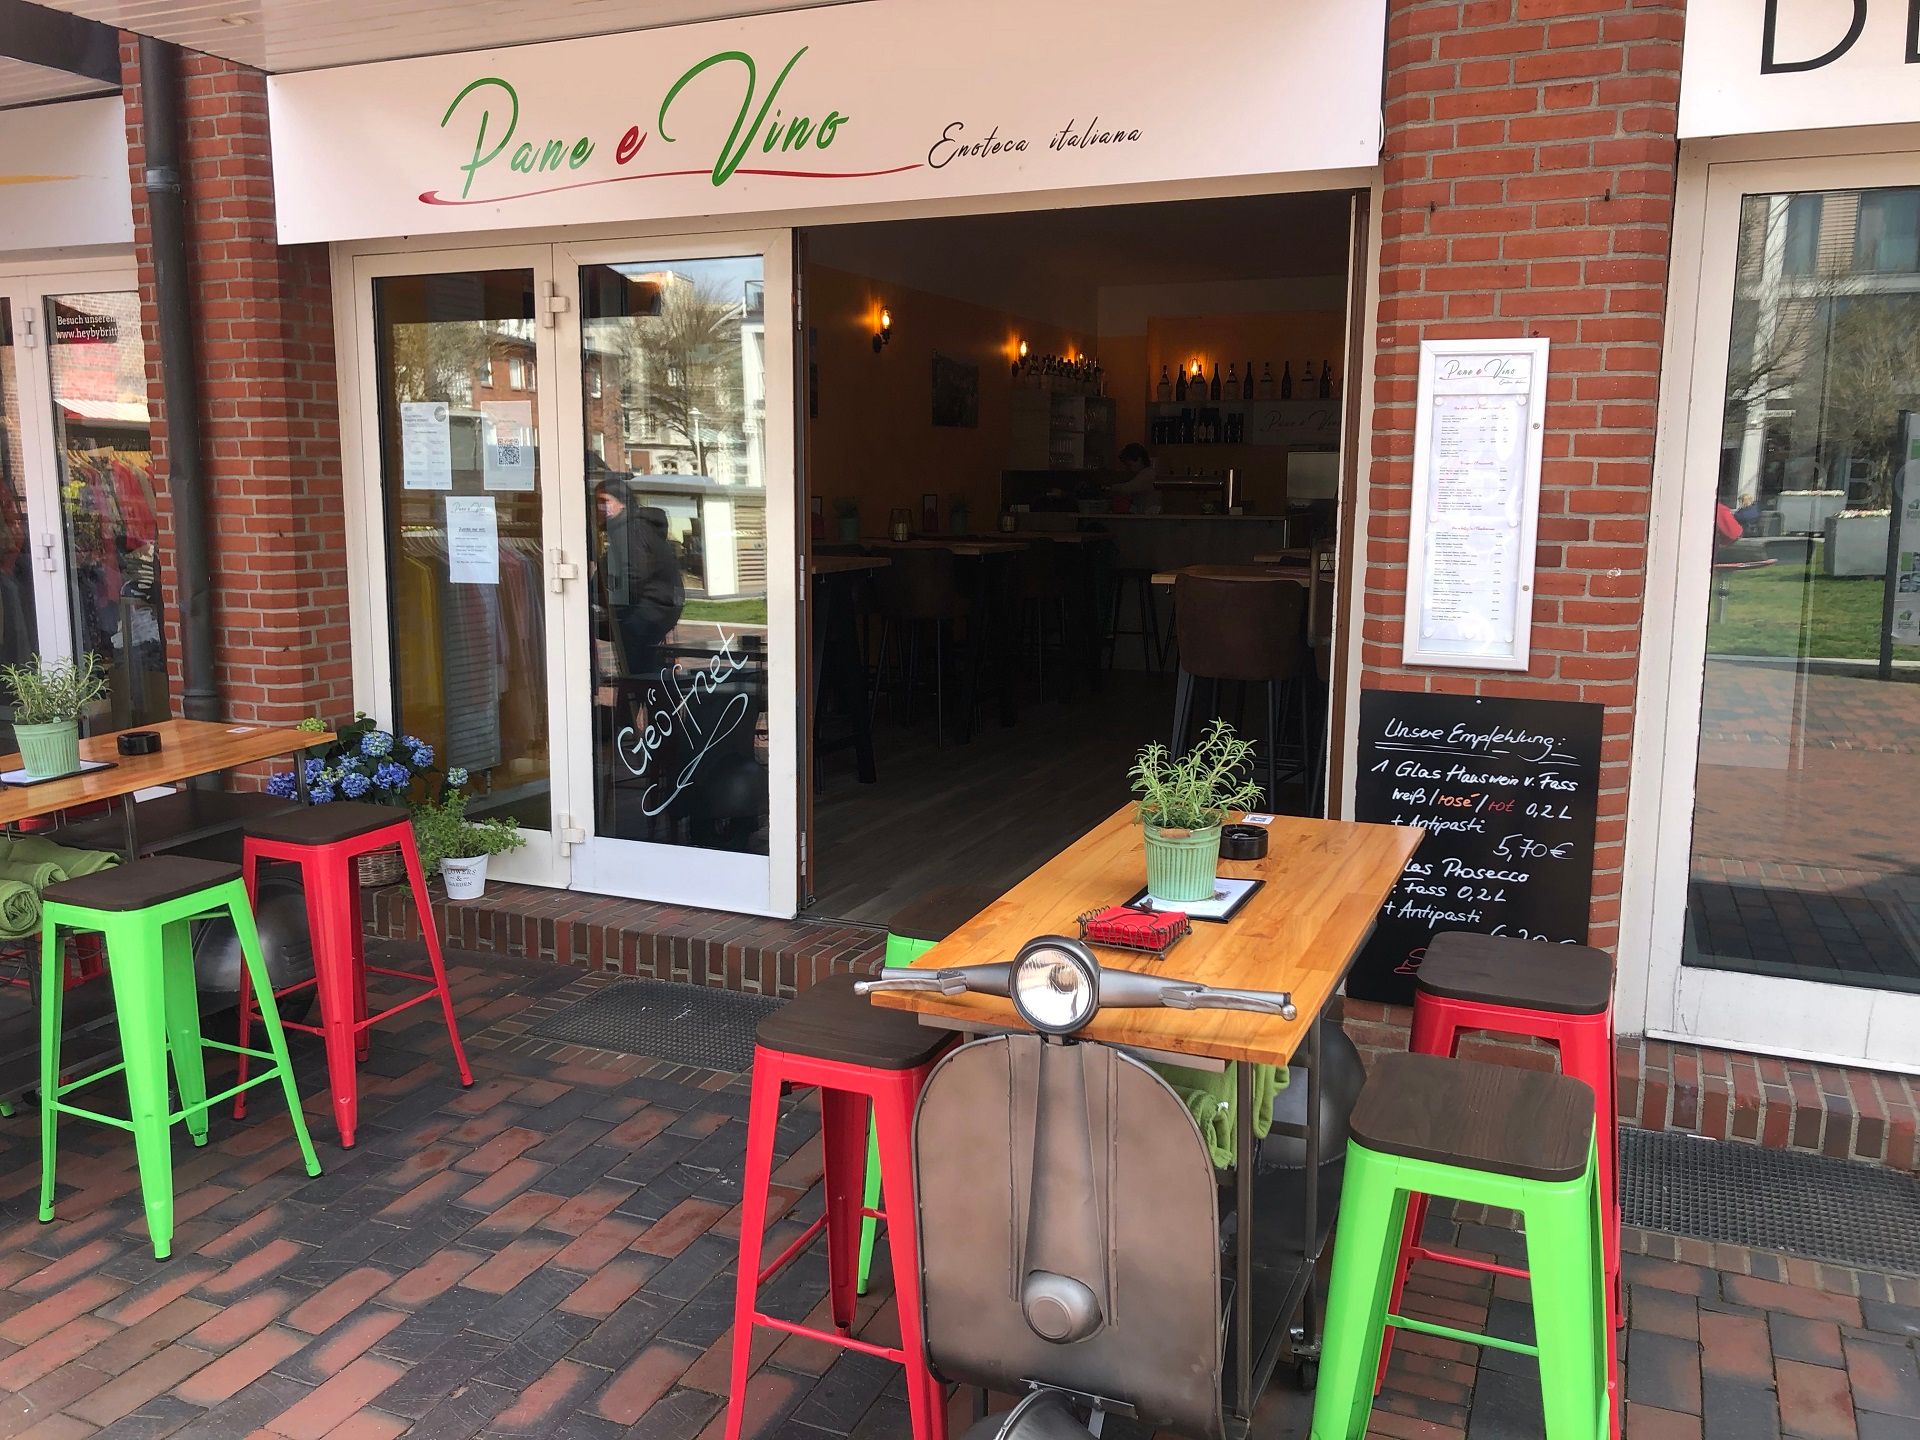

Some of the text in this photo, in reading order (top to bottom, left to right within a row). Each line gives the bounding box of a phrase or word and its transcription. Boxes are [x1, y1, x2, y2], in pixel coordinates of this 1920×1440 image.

[441, 46, 849, 199] Pane e Vino
[928, 115, 1143, 169] Enoteca italiana
[57, 315, 84, 326] Besuch
[617, 623, 749, 775] Geöffnet
[1384, 717, 1566, 762] Unsere Empfehlung:
[1370, 759, 1390, 772] 1
[1395, 760, 1442, 778] Glas
[1445, 763, 1519, 786] Hauswein
[1538, 771, 1579, 791] Fass
[1408, 814, 1486, 836] Antipasti
[1404, 857, 1530, 882] las Prosecco
[1397, 899, 1483, 929] Antipasti
